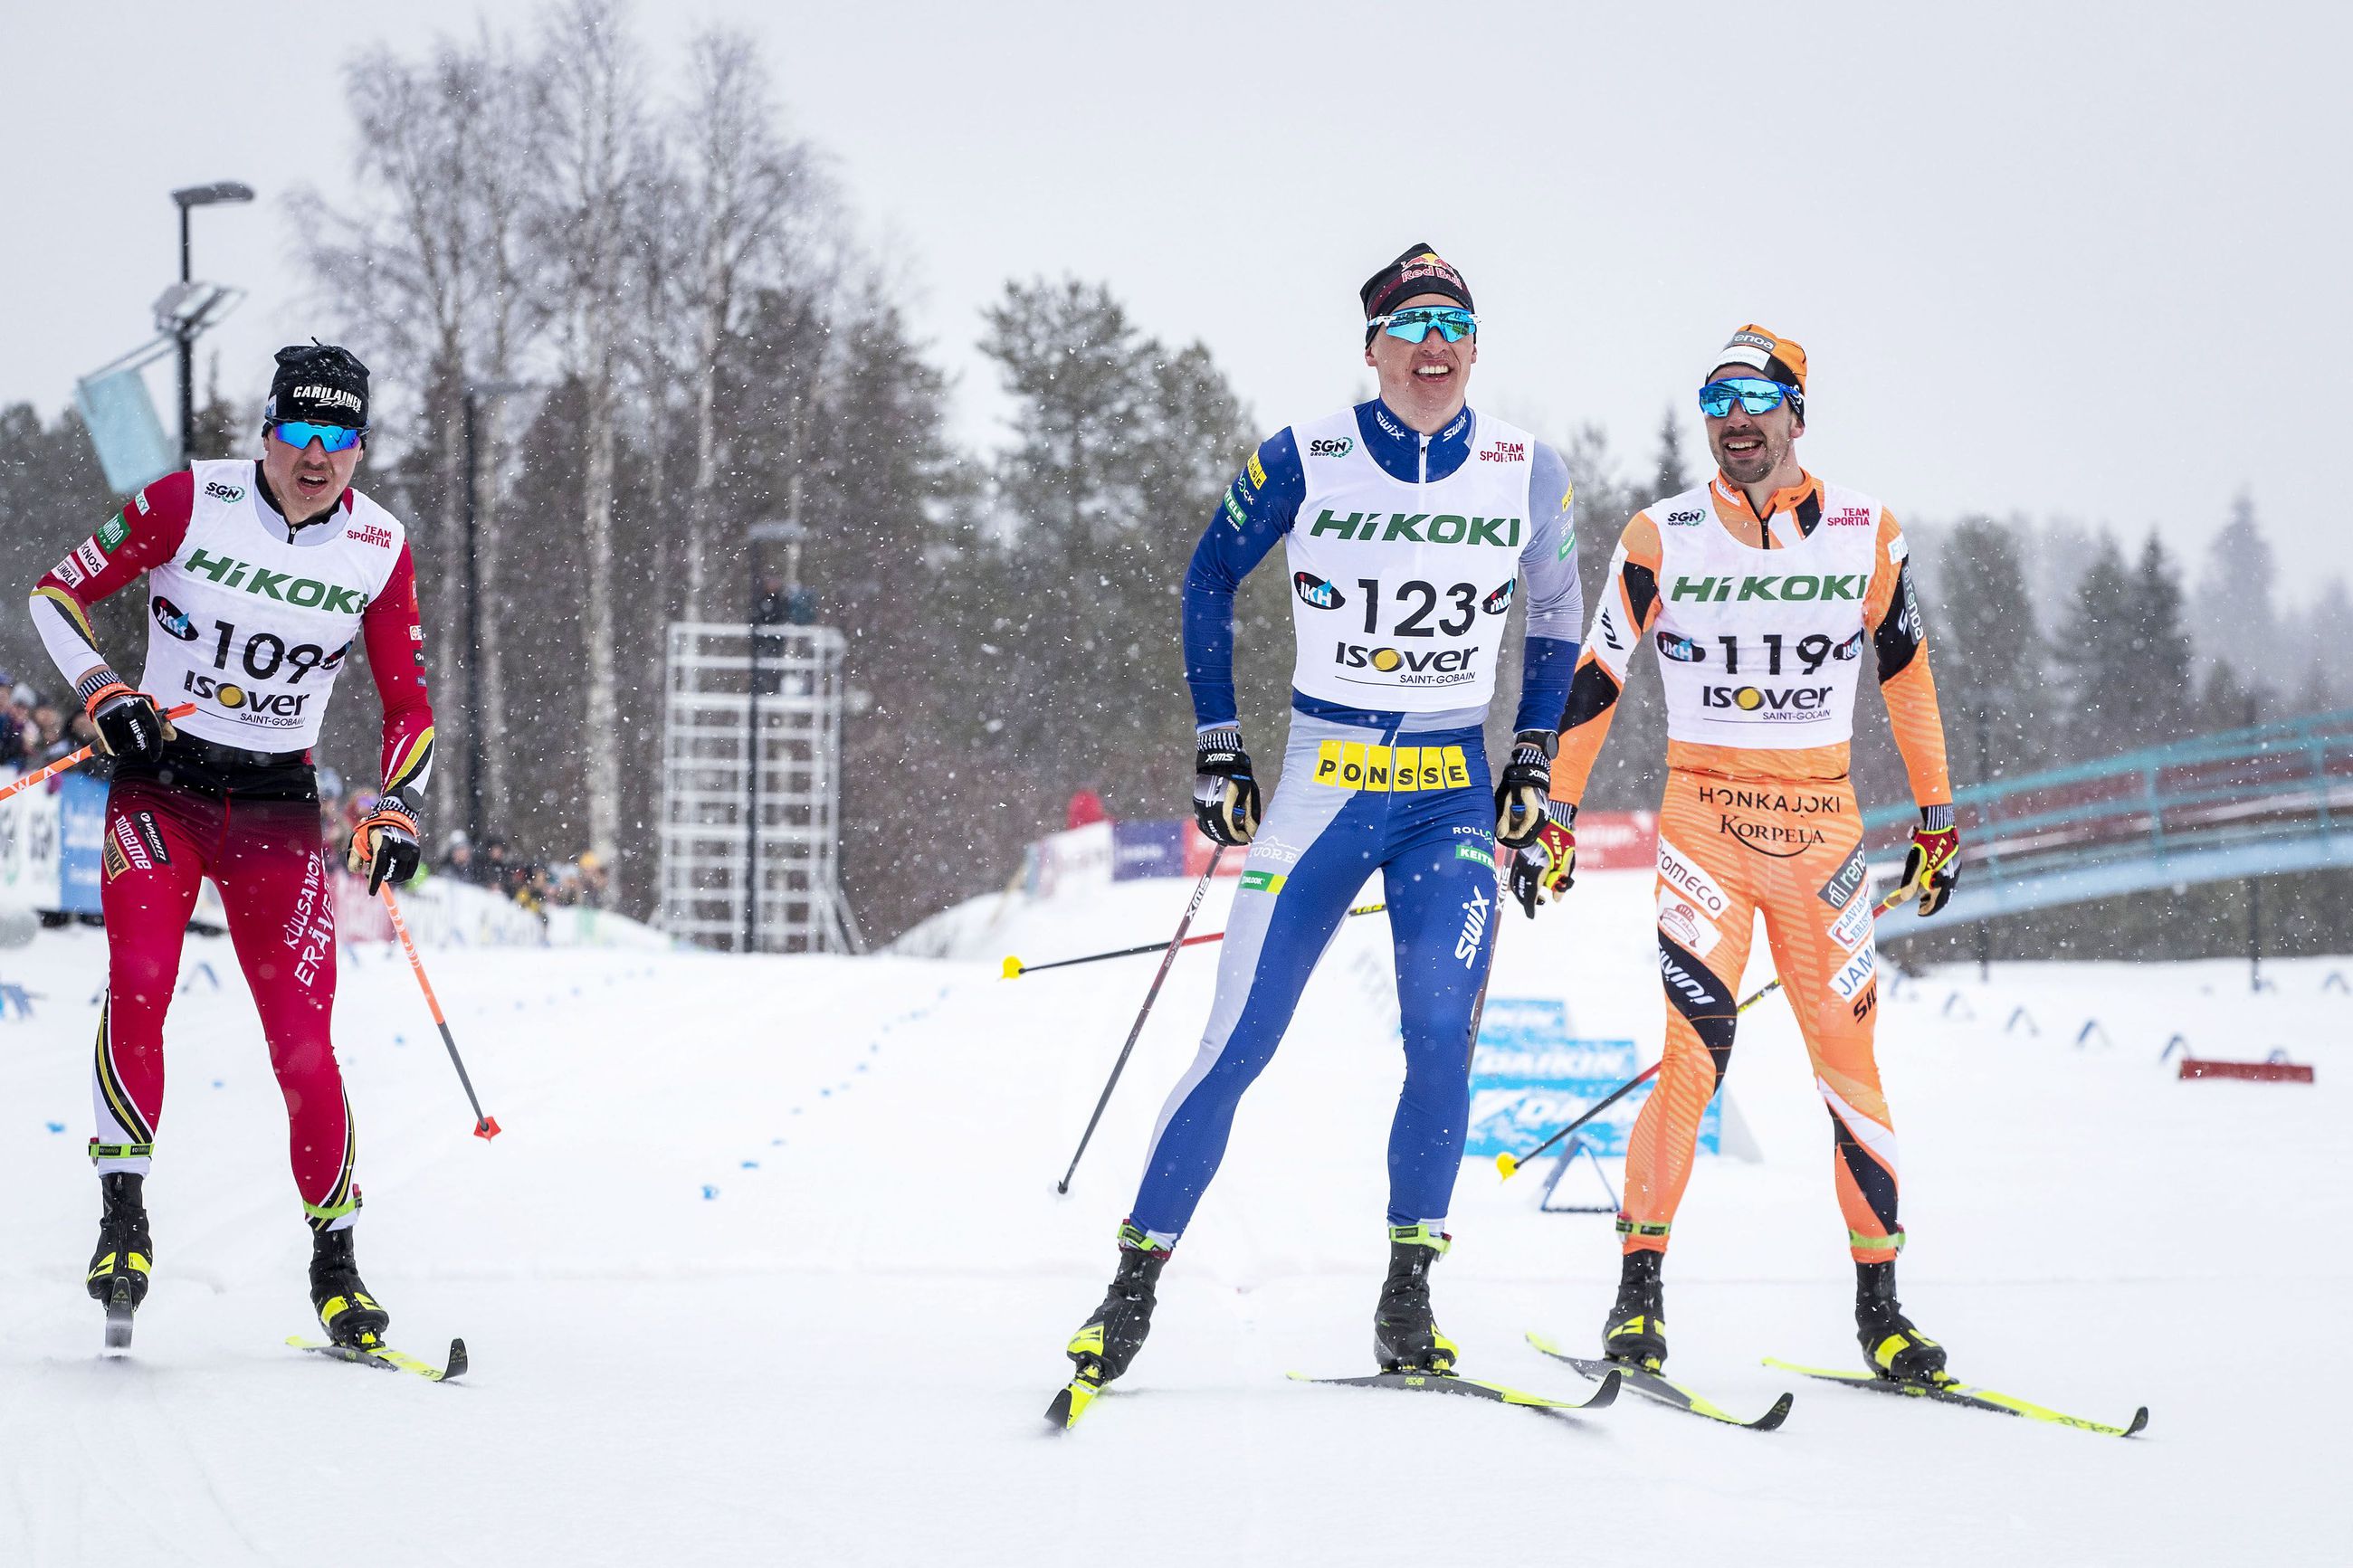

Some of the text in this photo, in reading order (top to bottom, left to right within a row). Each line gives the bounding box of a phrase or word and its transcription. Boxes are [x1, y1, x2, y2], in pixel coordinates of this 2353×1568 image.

[1401, 266, 1462, 290] Red Bull
[293, 386, 362, 407] CARILAINEN
[1310, 439, 1347, 452] SGN
[1495, 442, 1524, 453] TEAM
[1480, 451, 1525, 462] SPORTIA
[206, 482, 239, 499] SGN
[1667, 511, 1700, 522] SGN
[1827, 517, 1871, 526] SPORTIA
[1843, 508, 1870, 518] TEAM
[347, 530, 391, 549] SPORTIA
[365, 525, 392, 539] TEAM
[1358, 578, 1477, 638] 123
[214, 619, 324, 685] 109
[1718, 634, 1834, 675] 119
[1399, 671, 1476, 684] SAINT-GOBAIN
[240, 712, 306, 727] SAINT-GOBAIN
[1319, 758, 1465, 785] PONSSE
[1700, 786, 1840, 813] HONKAJOKI
[145, 822, 167, 861] VAUHTI
[1550, 831, 1563, 864] LEKI
[1840, 843, 1866, 890] reno
[283, 851, 321, 950] KUUSAMON
[1405, 1376, 1425, 1386] FISCHER
